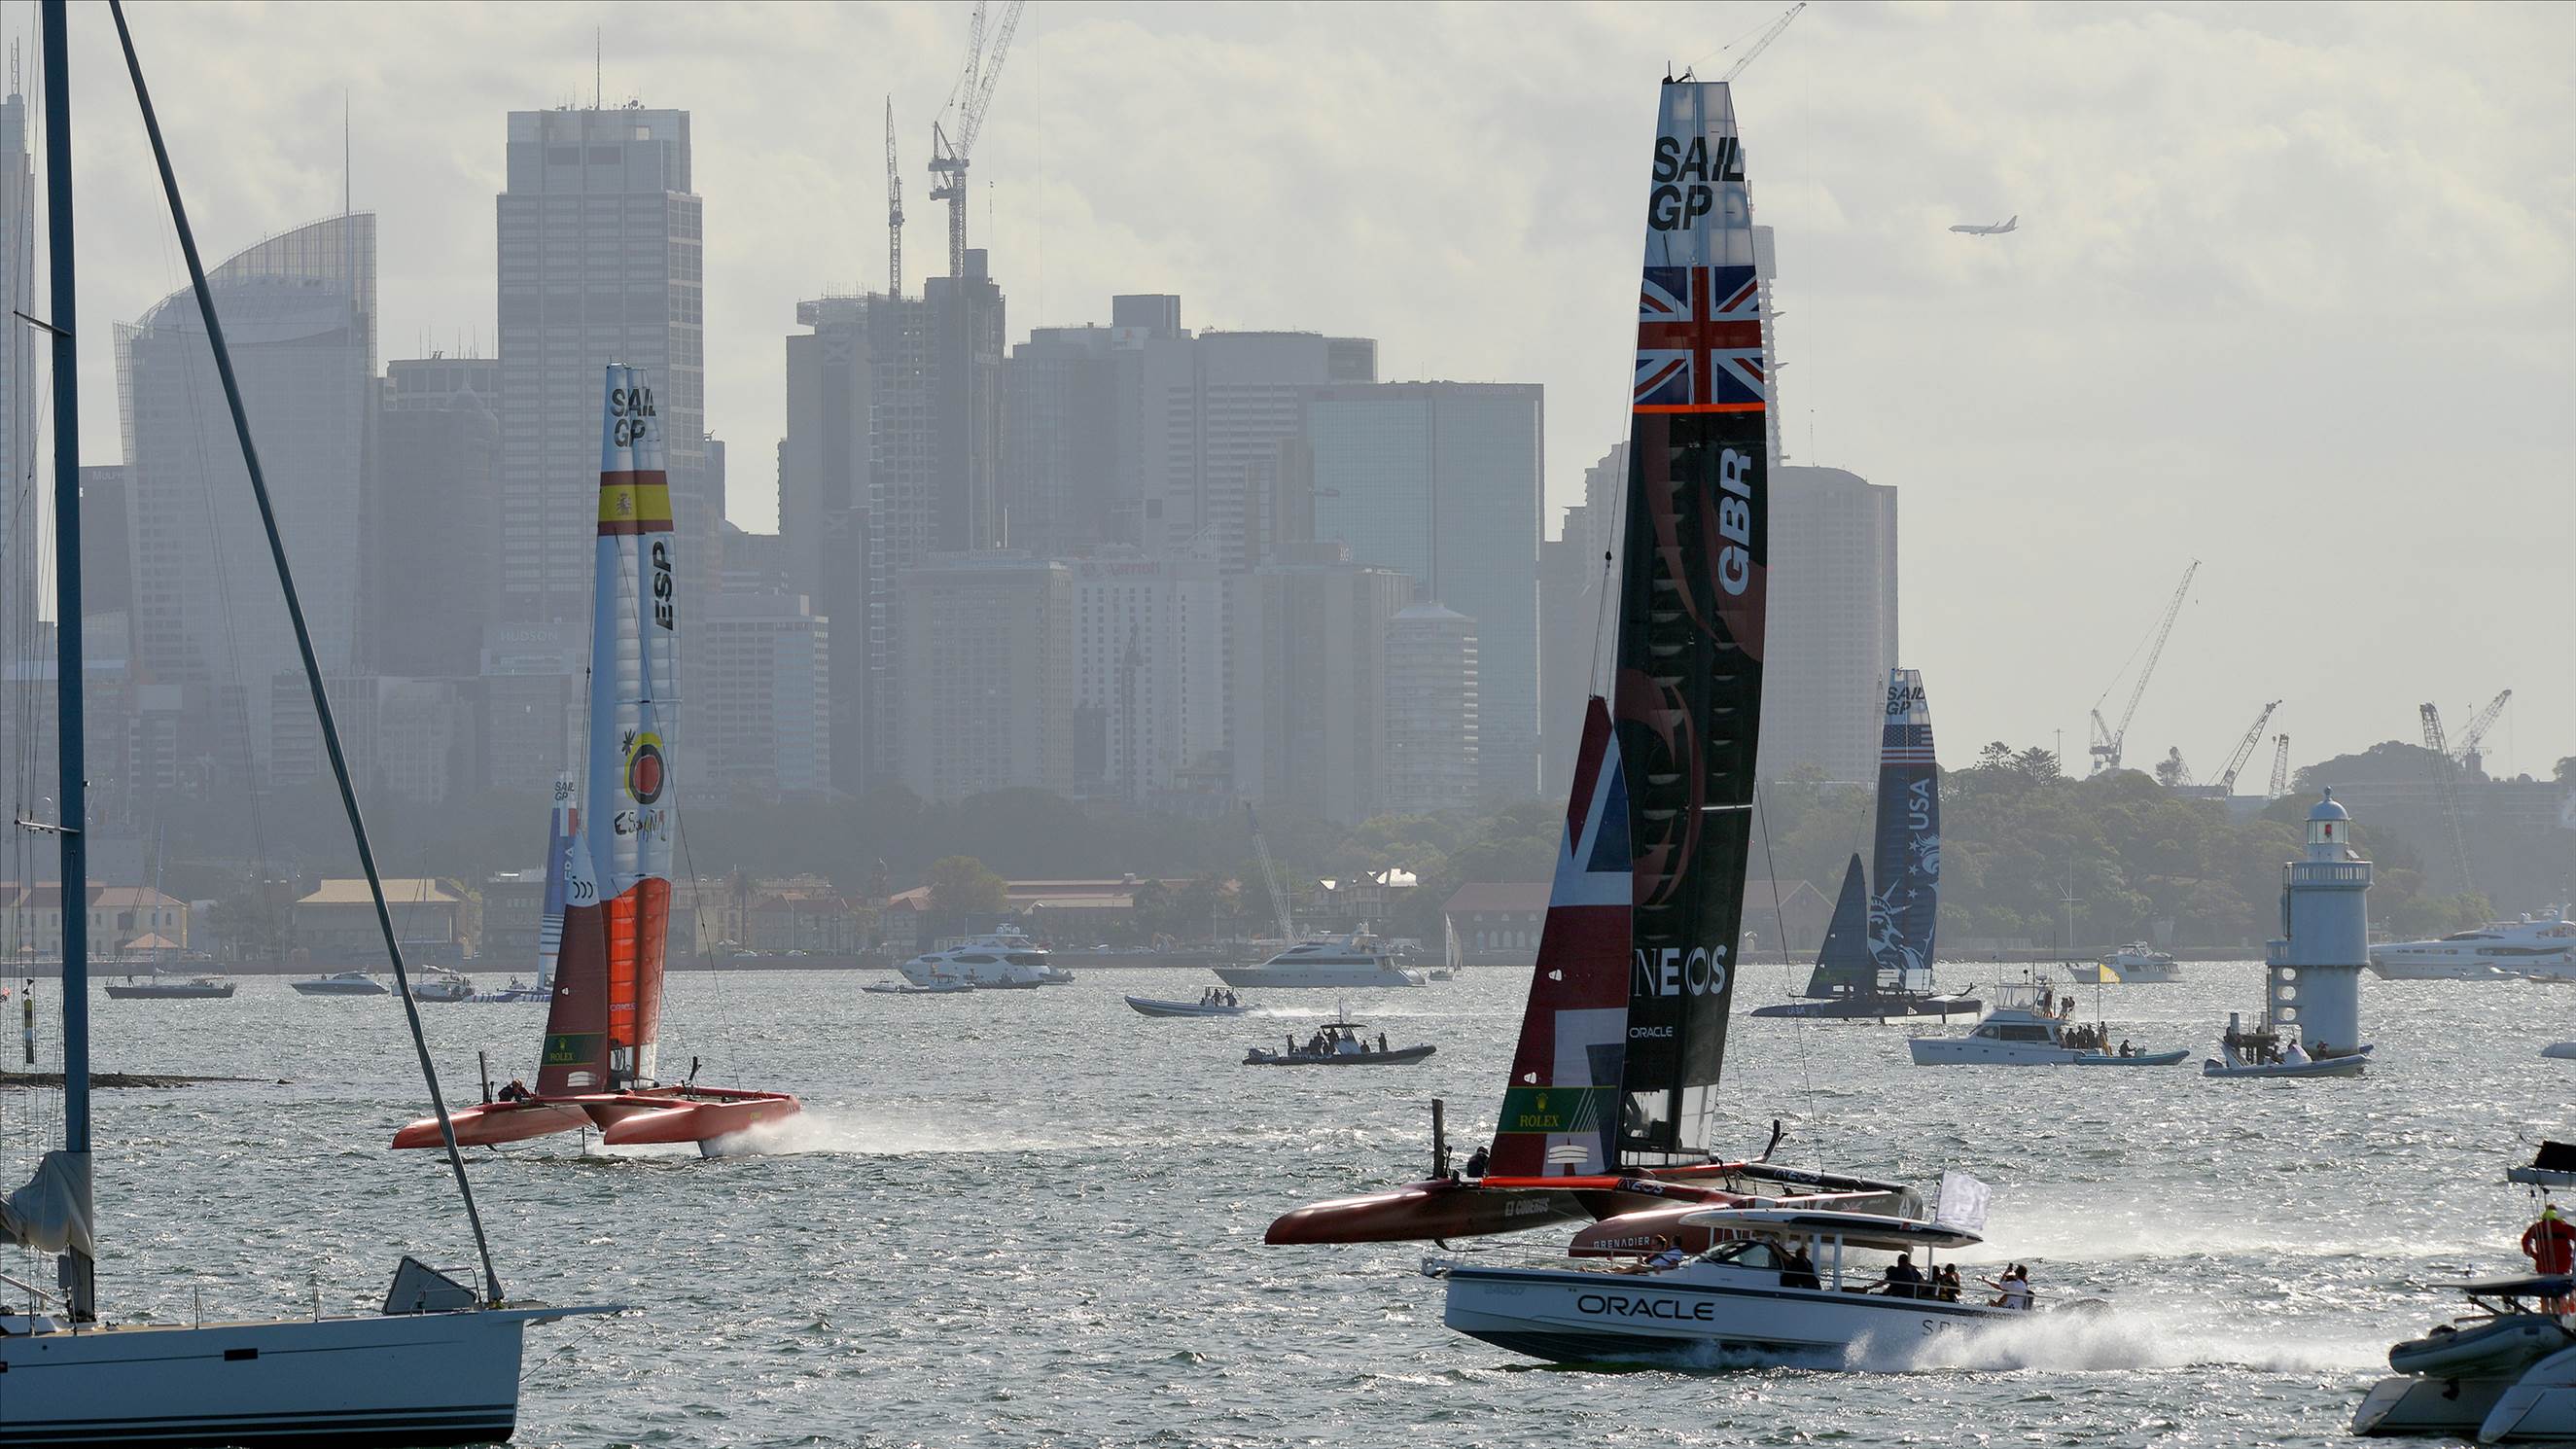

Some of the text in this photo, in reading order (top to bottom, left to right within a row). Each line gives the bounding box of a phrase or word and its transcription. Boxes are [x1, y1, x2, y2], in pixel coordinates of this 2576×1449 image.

[1652, 136, 1745, 182] SAIL
[1648, 185, 1713, 231] GP
[610, 388, 656, 417] SAIL
[614, 418, 646, 447] GP
[1718, 448, 1750, 595] GBR
[653, 541, 673, 631] ESP
[1888, 687, 1924, 700] SAIL
[1887, 701, 1911, 715] GP
[554, 782, 575, 792] SAIL
[555, 792, 568, 801] GP
[1909, 779, 1929, 830] USA
[1632, 944, 1727, 997] NEOS
[1629, 1026, 1673, 1039] ORACLE
[550, 1052, 575, 1062] ROLEX
[1519, 1113, 1559, 1128] ROLEX
[1773, 1169, 1820, 1183] INEOS
[1617, 1178, 1665, 1194] INEOS
[1593, 1236, 1650, 1249] GRENADIER
[1577, 1294, 1714, 1321] ORACLE
